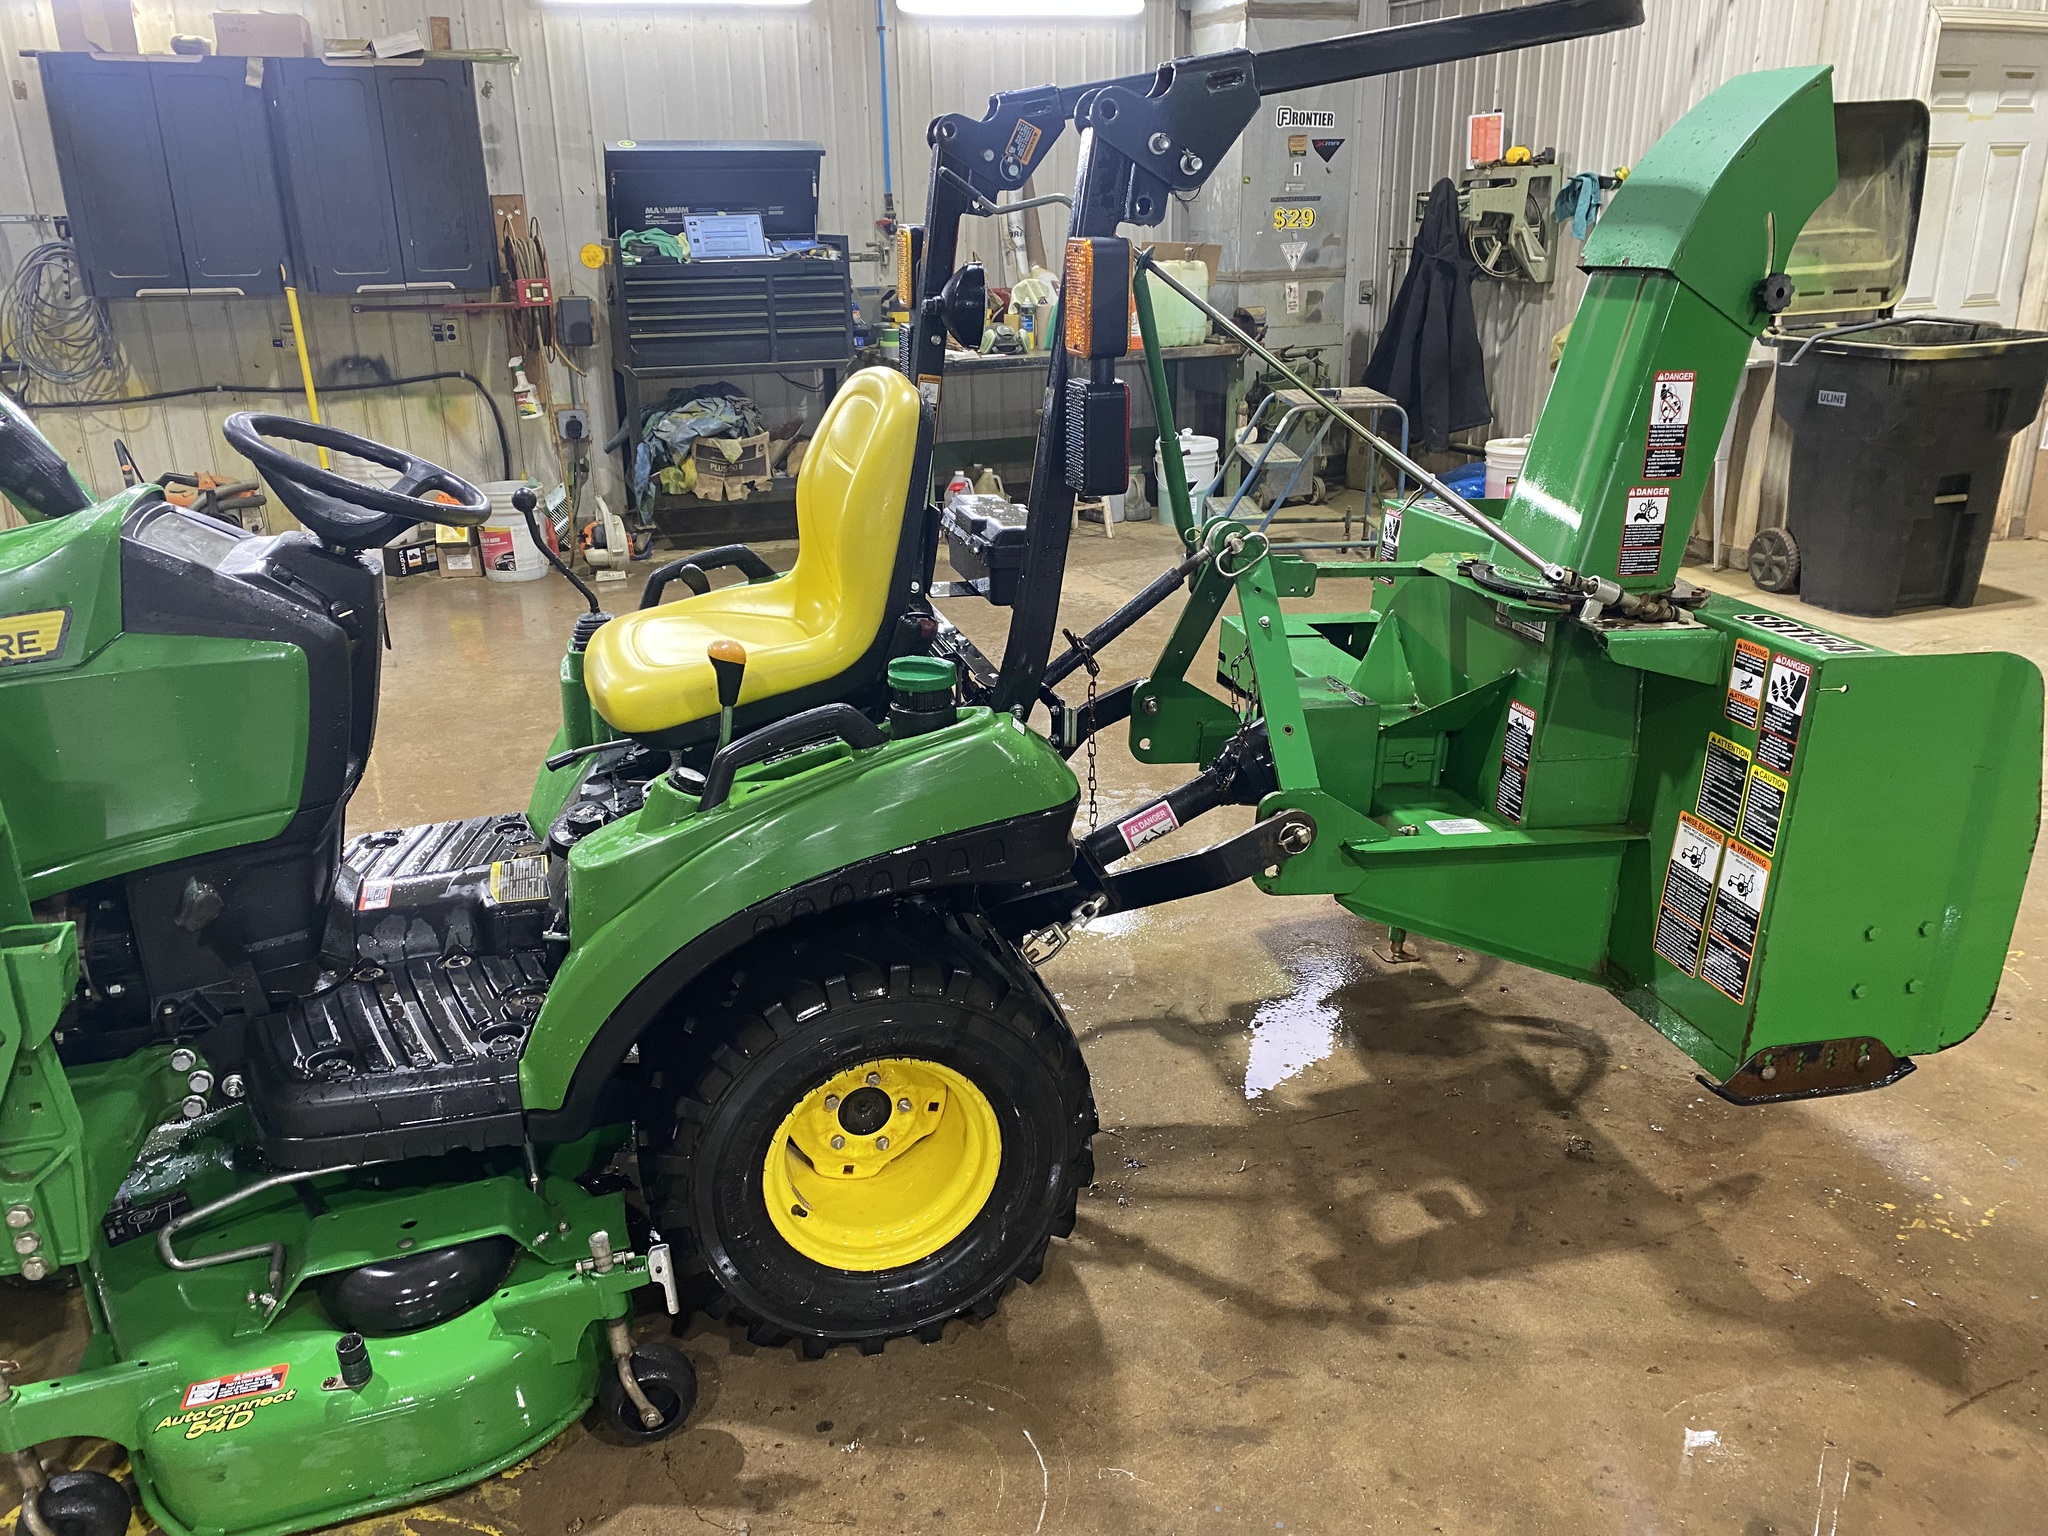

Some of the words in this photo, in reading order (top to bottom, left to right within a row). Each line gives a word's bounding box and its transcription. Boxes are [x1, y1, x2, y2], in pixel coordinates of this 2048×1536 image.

[1277, 107, 1334, 127] FRONTIER
[644, 206, 690, 215] MAXIMUM
[1272, 207, 1315, 231] $29
[1664, 372, 1694, 381] DANGER
[1819, 392, 1846, 405] ULINE
[1636, 487, 1670, 496] DANGER
[1743, 643, 1768, 658] WARNING
[1780, 657, 1811, 675] DANGER
[1733, 692, 1759, 709] ATTENTION
[1514, 702, 1536, 719] DANGER
[1716, 738, 1750, 759] ATTENTION
[1759, 771, 1787, 790] CAUTION
[1138, 810, 1168, 830] DANGER
[1685, 816, 1699, 828] MISE
[1705, 826, 1723, 842] GARDE
[1737, 844, 1767, 868] WARNING
[242, 1368, 273, 1379] DANGER
[152, 1387, 298, 1435] AutoConnect
[184, 1409, 256, 1441] 54D
